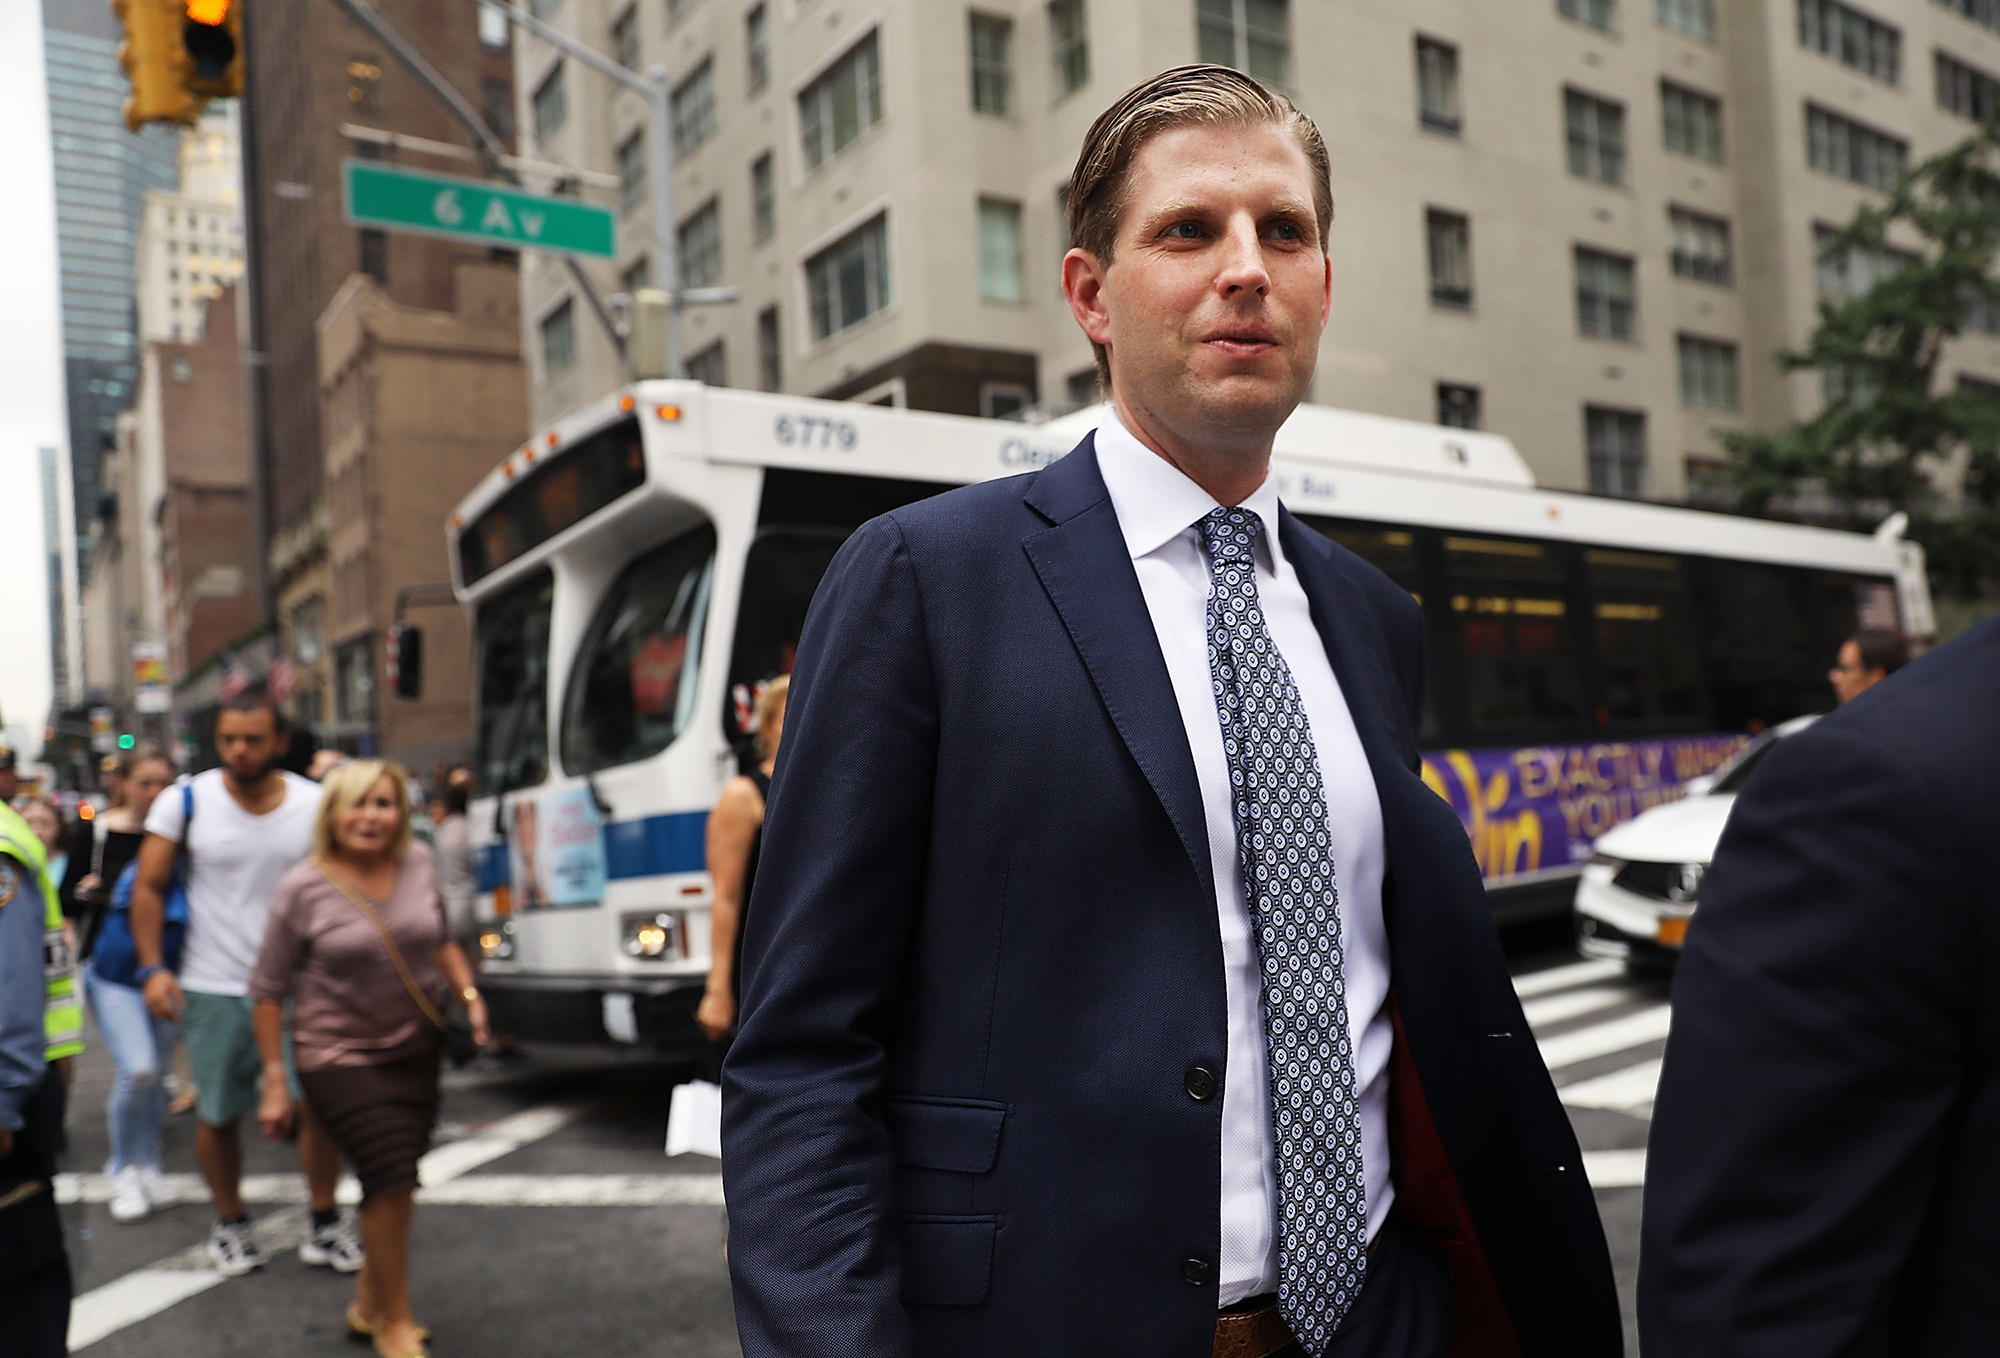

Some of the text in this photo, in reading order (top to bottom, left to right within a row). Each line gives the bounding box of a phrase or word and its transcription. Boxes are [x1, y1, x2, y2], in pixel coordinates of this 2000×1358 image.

[432, 189, 547, 238] 6 Av
[774, 413, 858, 451] 6779
[1512, 742, 1663, 798] EXACTLY
